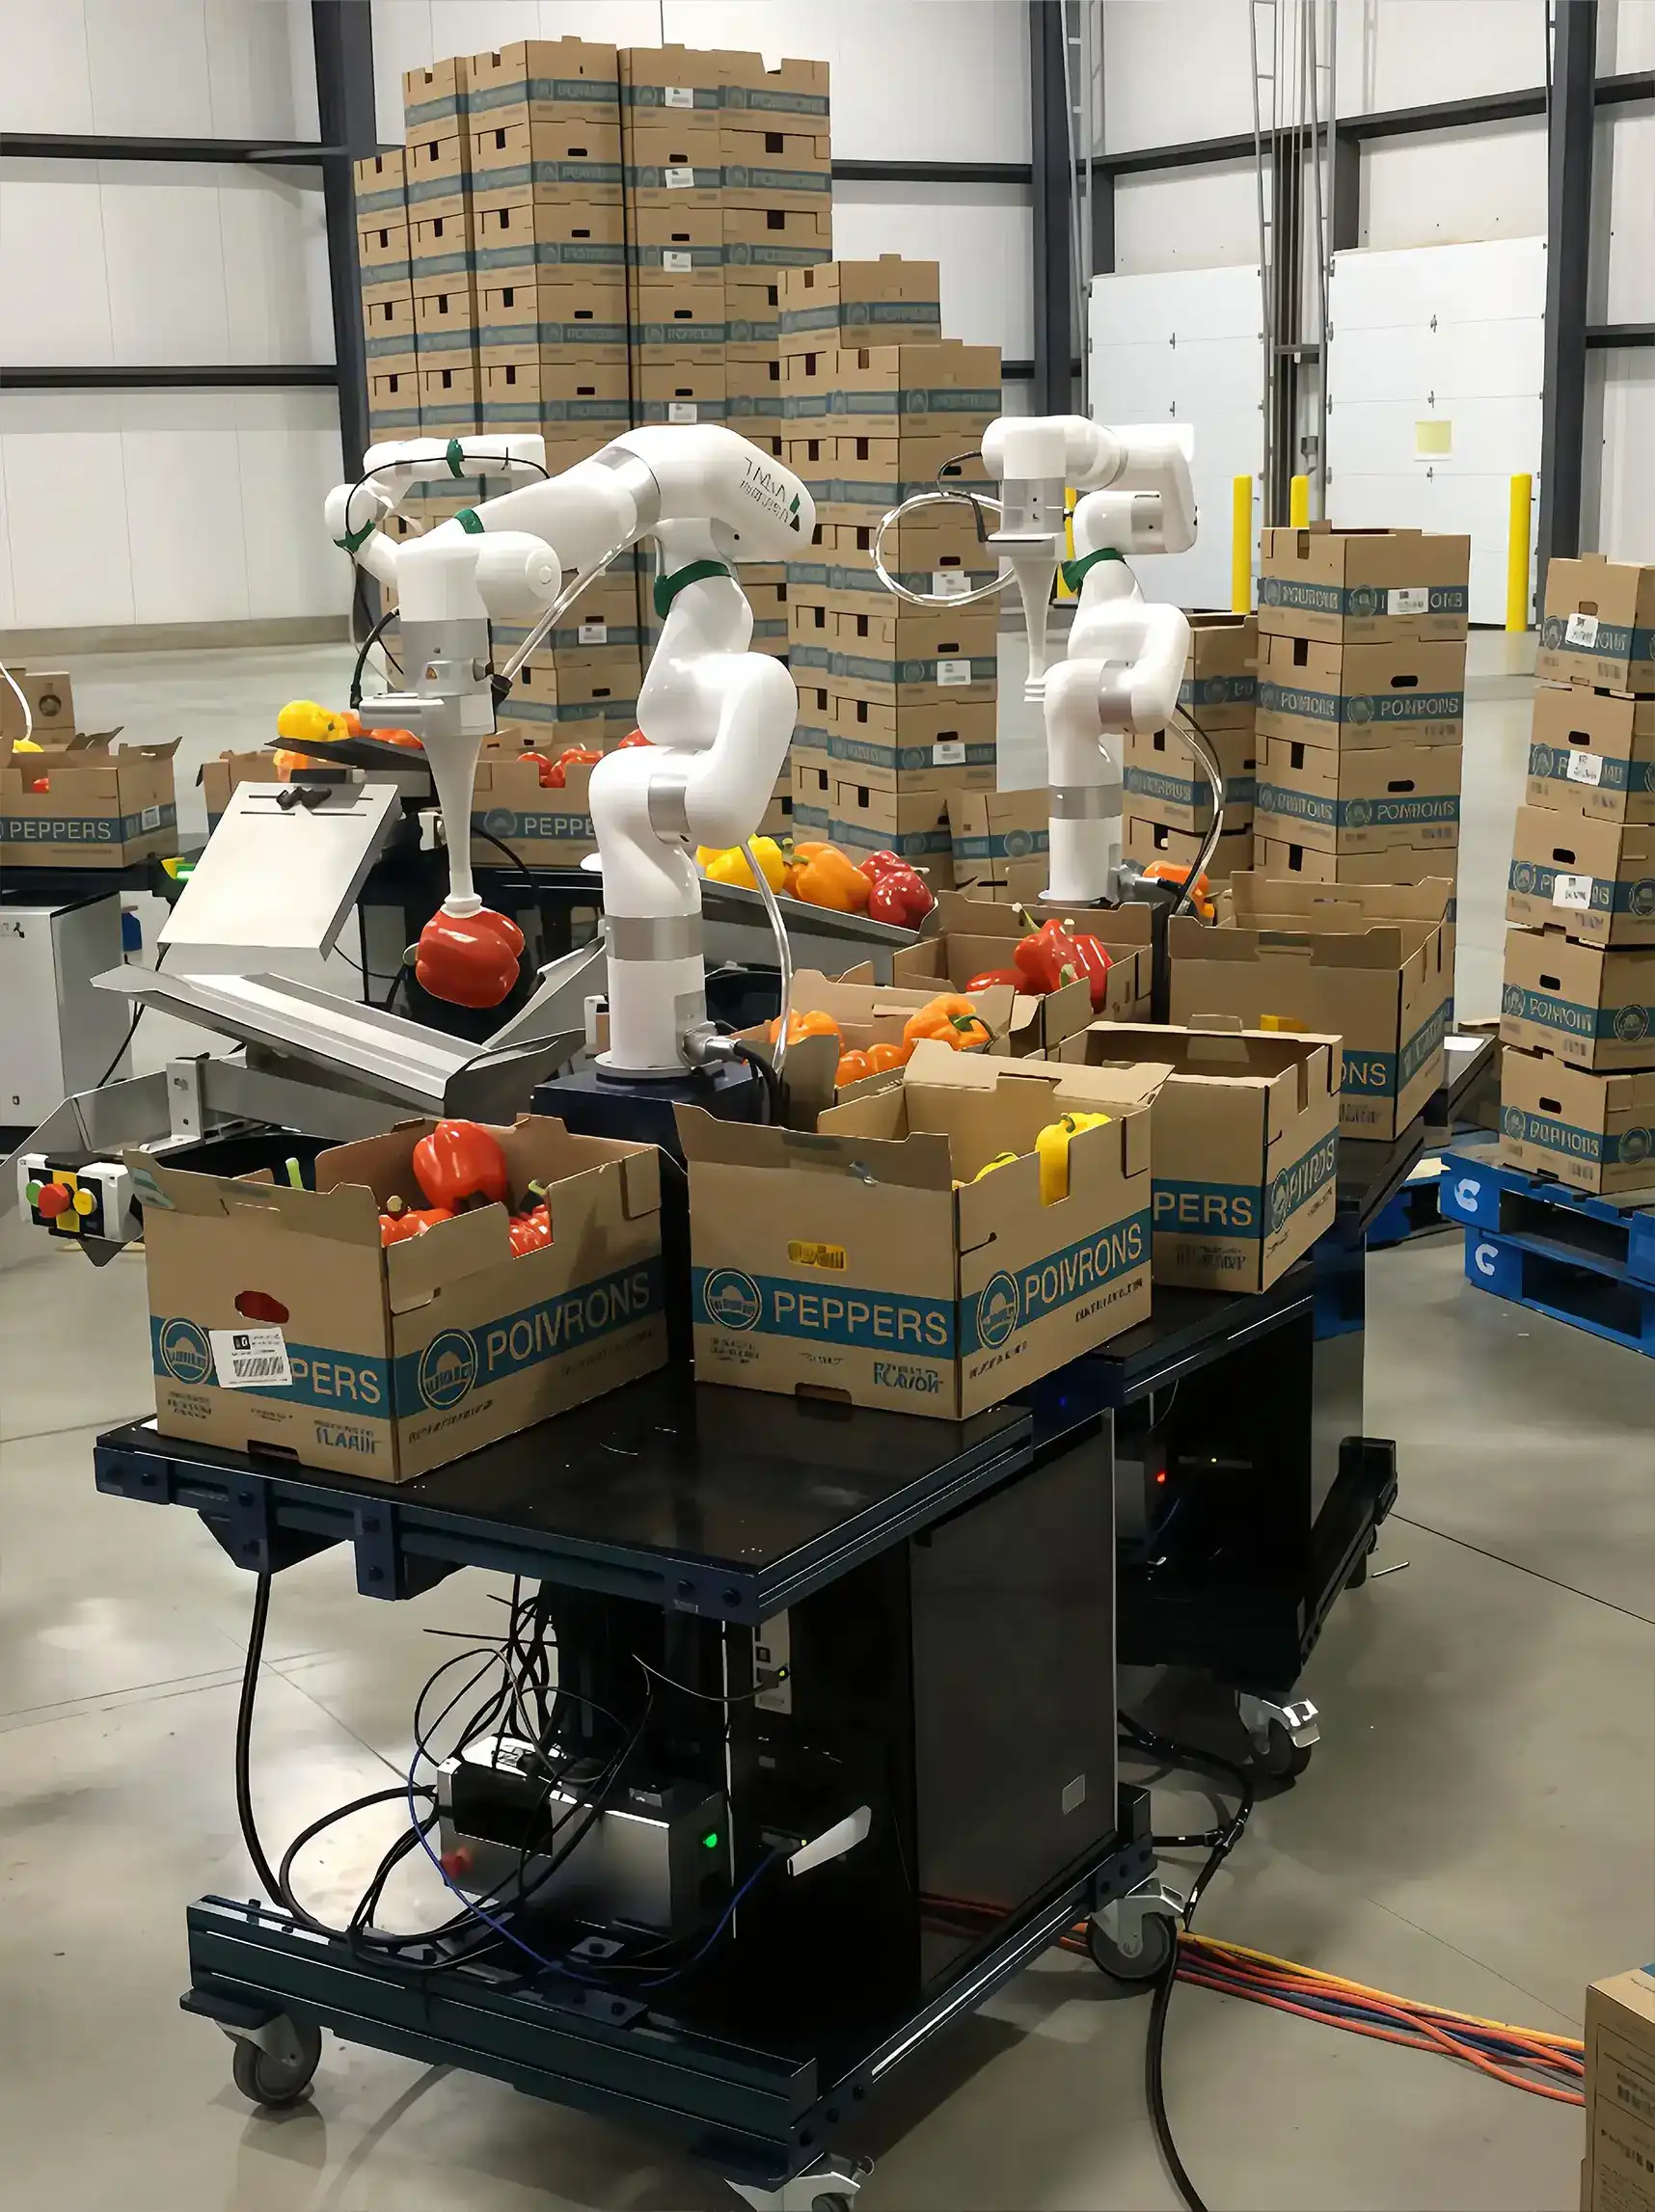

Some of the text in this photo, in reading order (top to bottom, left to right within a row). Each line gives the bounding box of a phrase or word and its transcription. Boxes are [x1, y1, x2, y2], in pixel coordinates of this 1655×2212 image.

[10, 822, 112, 840] PEPPERS
[524, 818, 595, 836] PEPPE
[1153, 1192, 1253, 1227] PERS
[1025, 1223, 1143, 1315] POIVRONS
[487, 1272, 650, 1371] POIVRONS
[773, 1290, 948, 1345] PEPPERS
[291, 1358, 381, 1404] PERS
